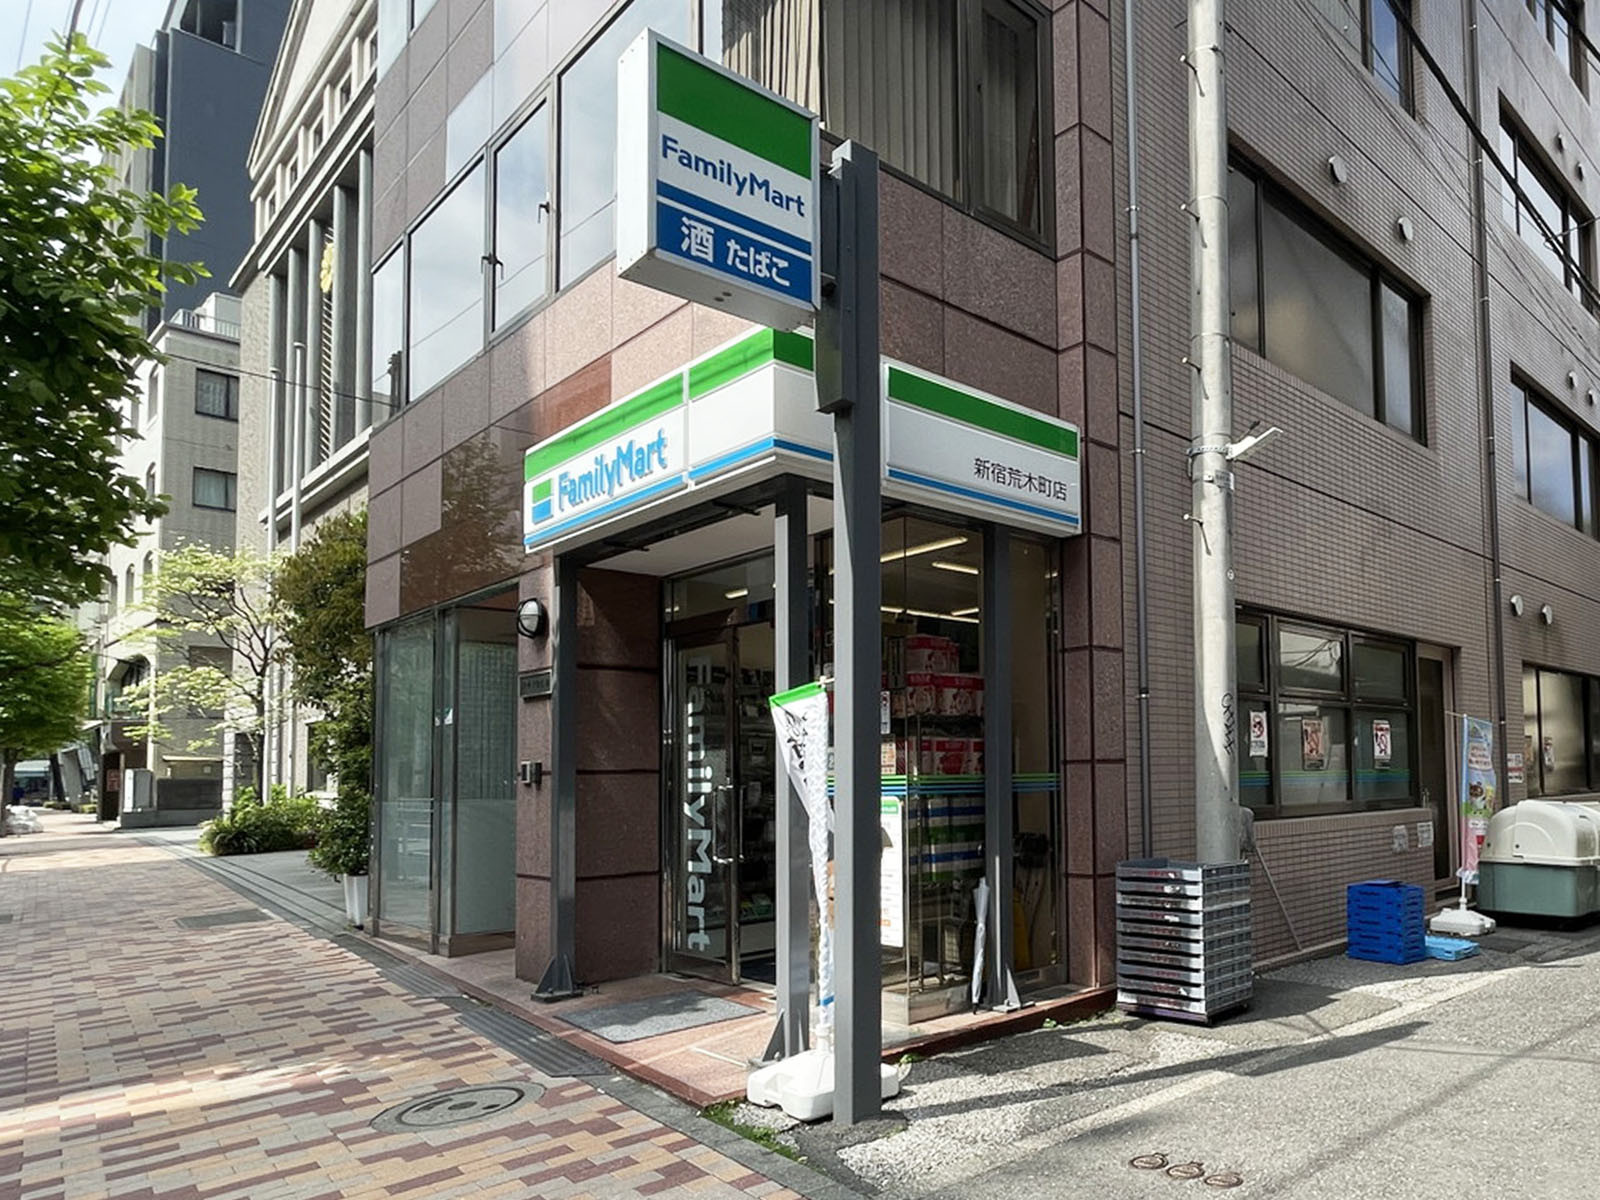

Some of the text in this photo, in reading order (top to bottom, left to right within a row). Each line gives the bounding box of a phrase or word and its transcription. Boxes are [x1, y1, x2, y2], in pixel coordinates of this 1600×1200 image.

[661, 134, 805, 217] FamilyMart
[681, 217, 789, 286] 酒 たばこ
[559, 427, 667, 511] FamilyMart
[974, 458, 1067, 501] 新宿荒木町店
[684, 656, 713, 951] FamilyMart
